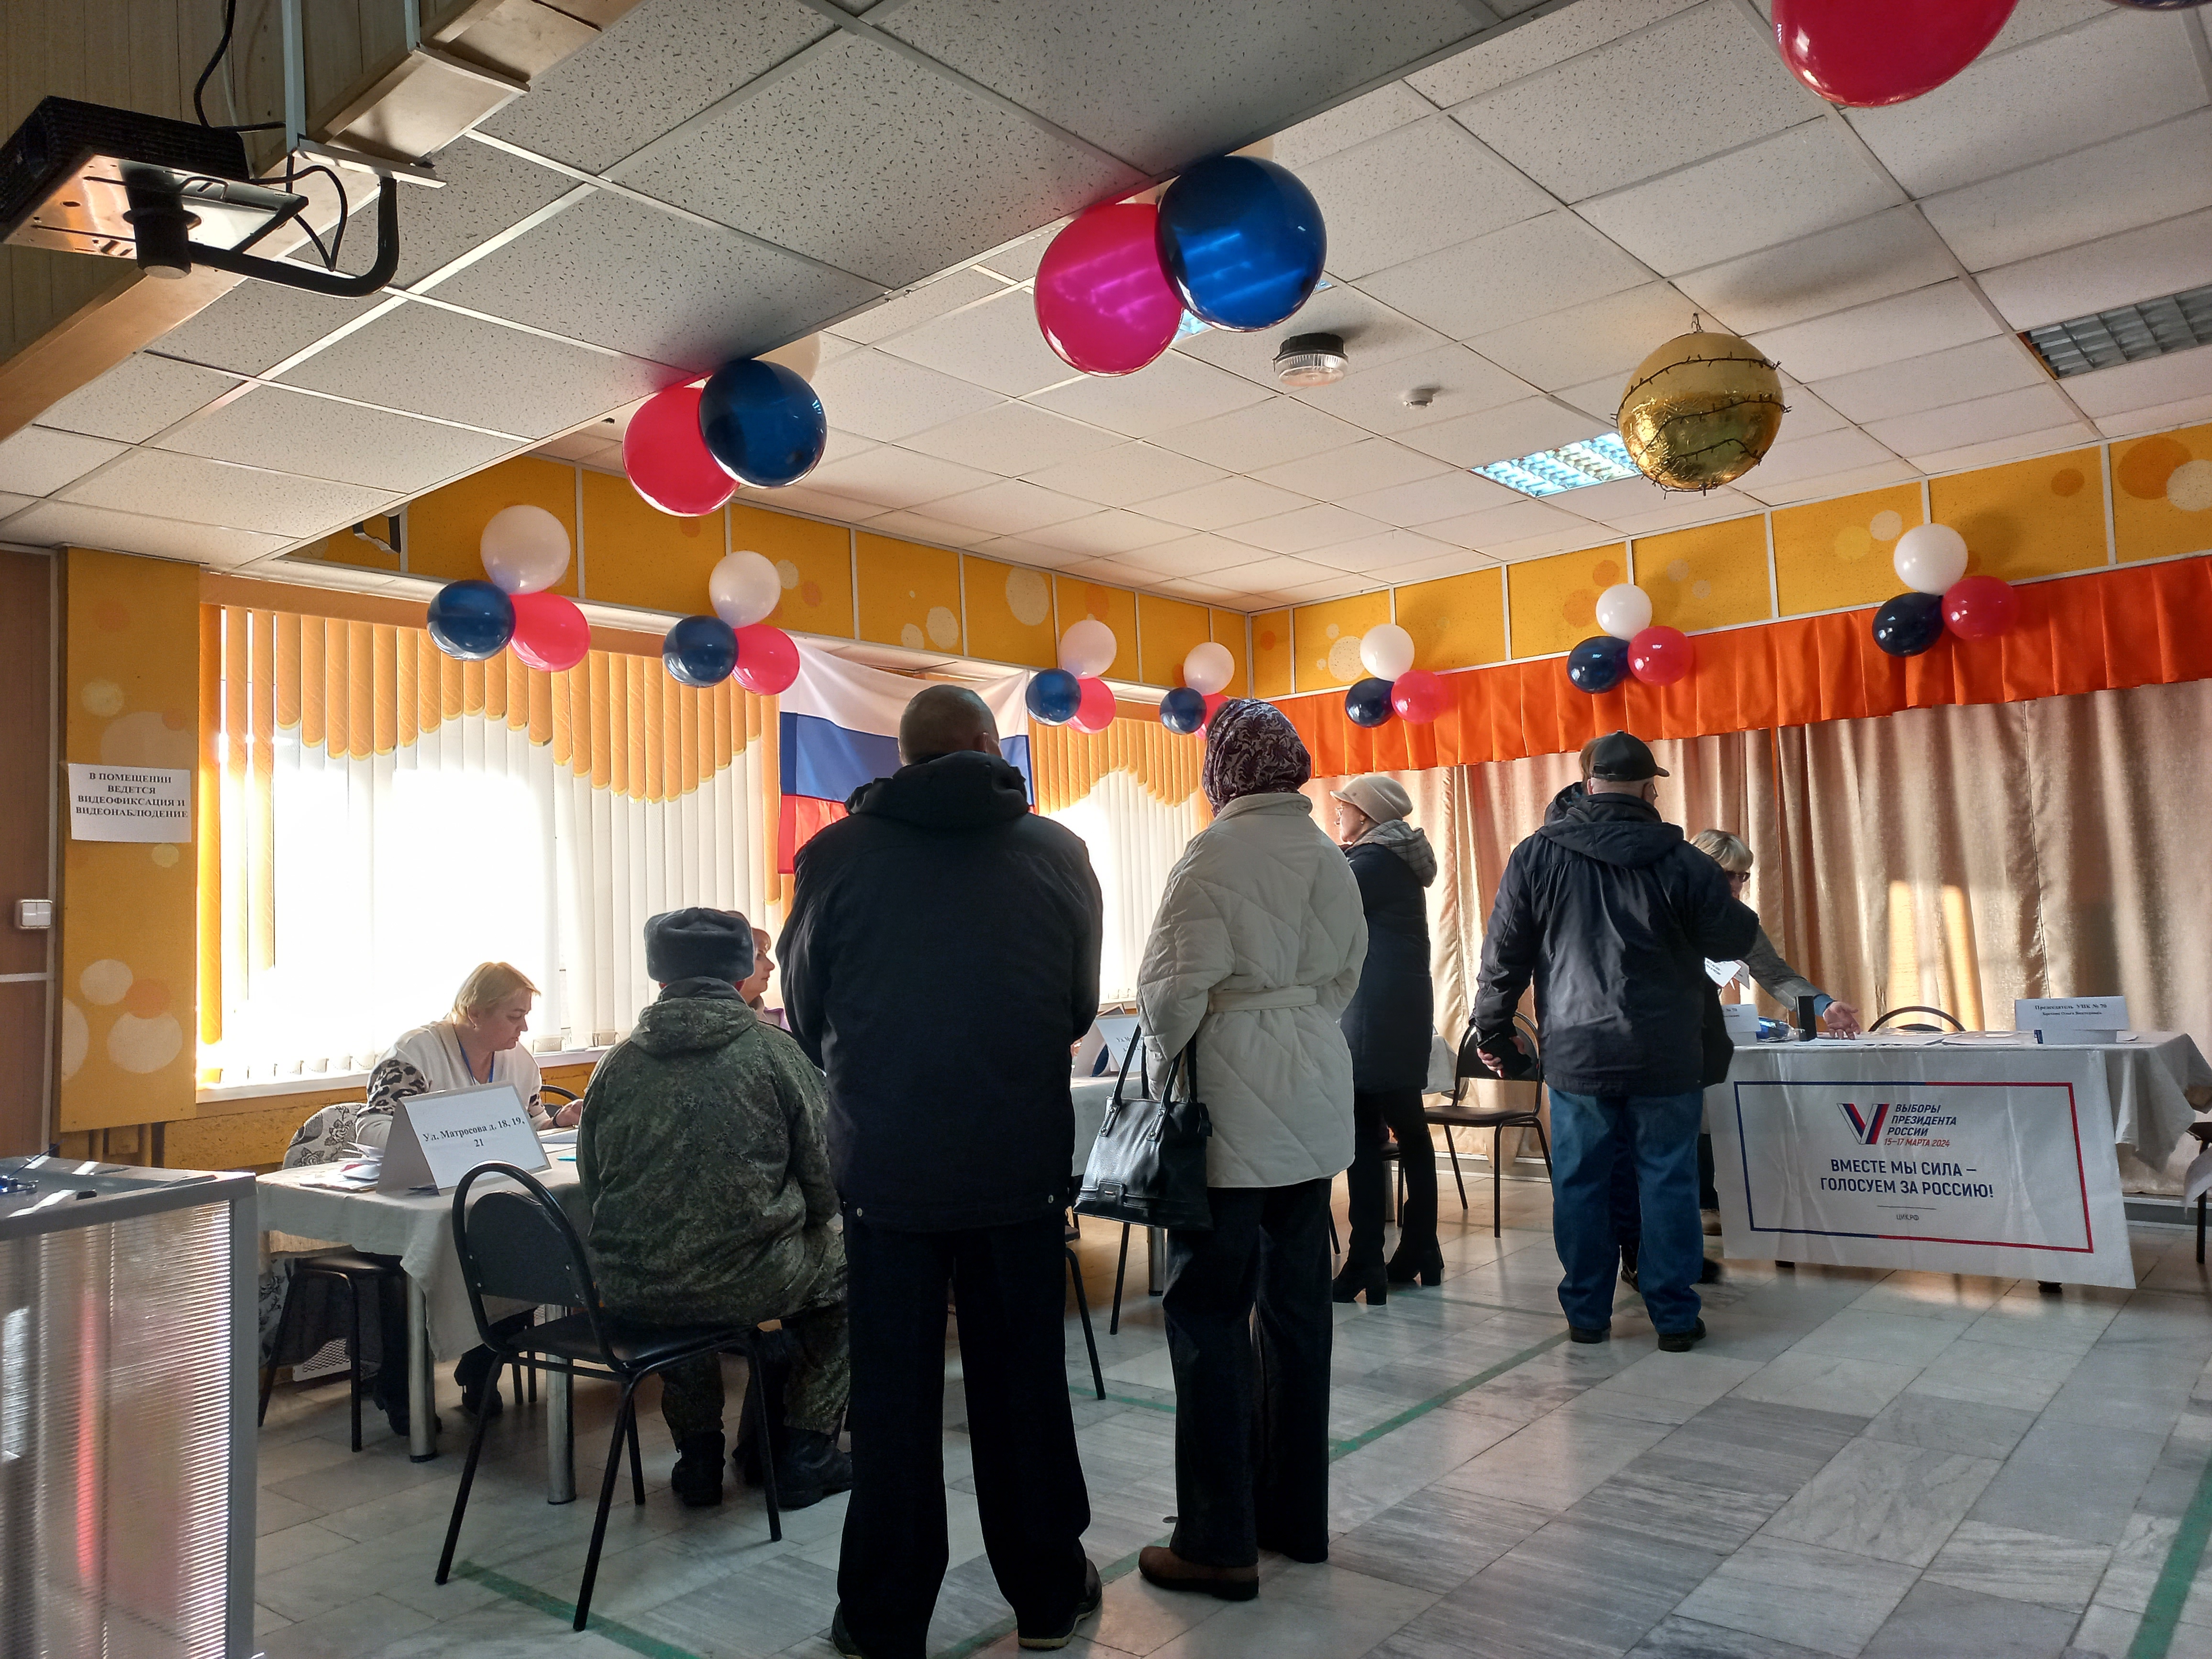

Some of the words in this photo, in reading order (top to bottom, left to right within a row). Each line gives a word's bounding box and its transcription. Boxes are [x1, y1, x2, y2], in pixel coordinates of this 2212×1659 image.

[99, 773, 171, 783] ПОМЕЩЕНИИ
[108, 785, 156, 794] ВЕДЕТСЯ
[78, 795, 174, 807] ВИДЕОФИКСАЦИЯ
[76, 807, 188, 818] ВИДЕОНАБЛЮДЕНИЕ
[1895, 1104, 1941, 1113] ВЫБОРЫ
[1891, 1116, 1957, 1126] ПРЕЗИДЕНТА
[423, 1133, 439, 1141] Ул.
[440, 1126, 487, 1138] Матросова
[498, 1119, 511, 1128] 18,
[512, 1117, 525, 1125] 19,
[1887, 1127, 1929, 1136] РОССИИ
[474, 1139, 484, 1147] 21
[1830, 1159, 1887, 1173] ВМЕСТЕ
[1891, 1161, 1917, 1175] МЫ
[1921, 1162, 1963, 1177] СИЛА
[1820, 1177, 1896, 1194] ГОЛОСУЕМ
[1901, 1180, 1919, 1194] ЗА
[1922, 1182, 1994, 1198] РОССИЮ!
